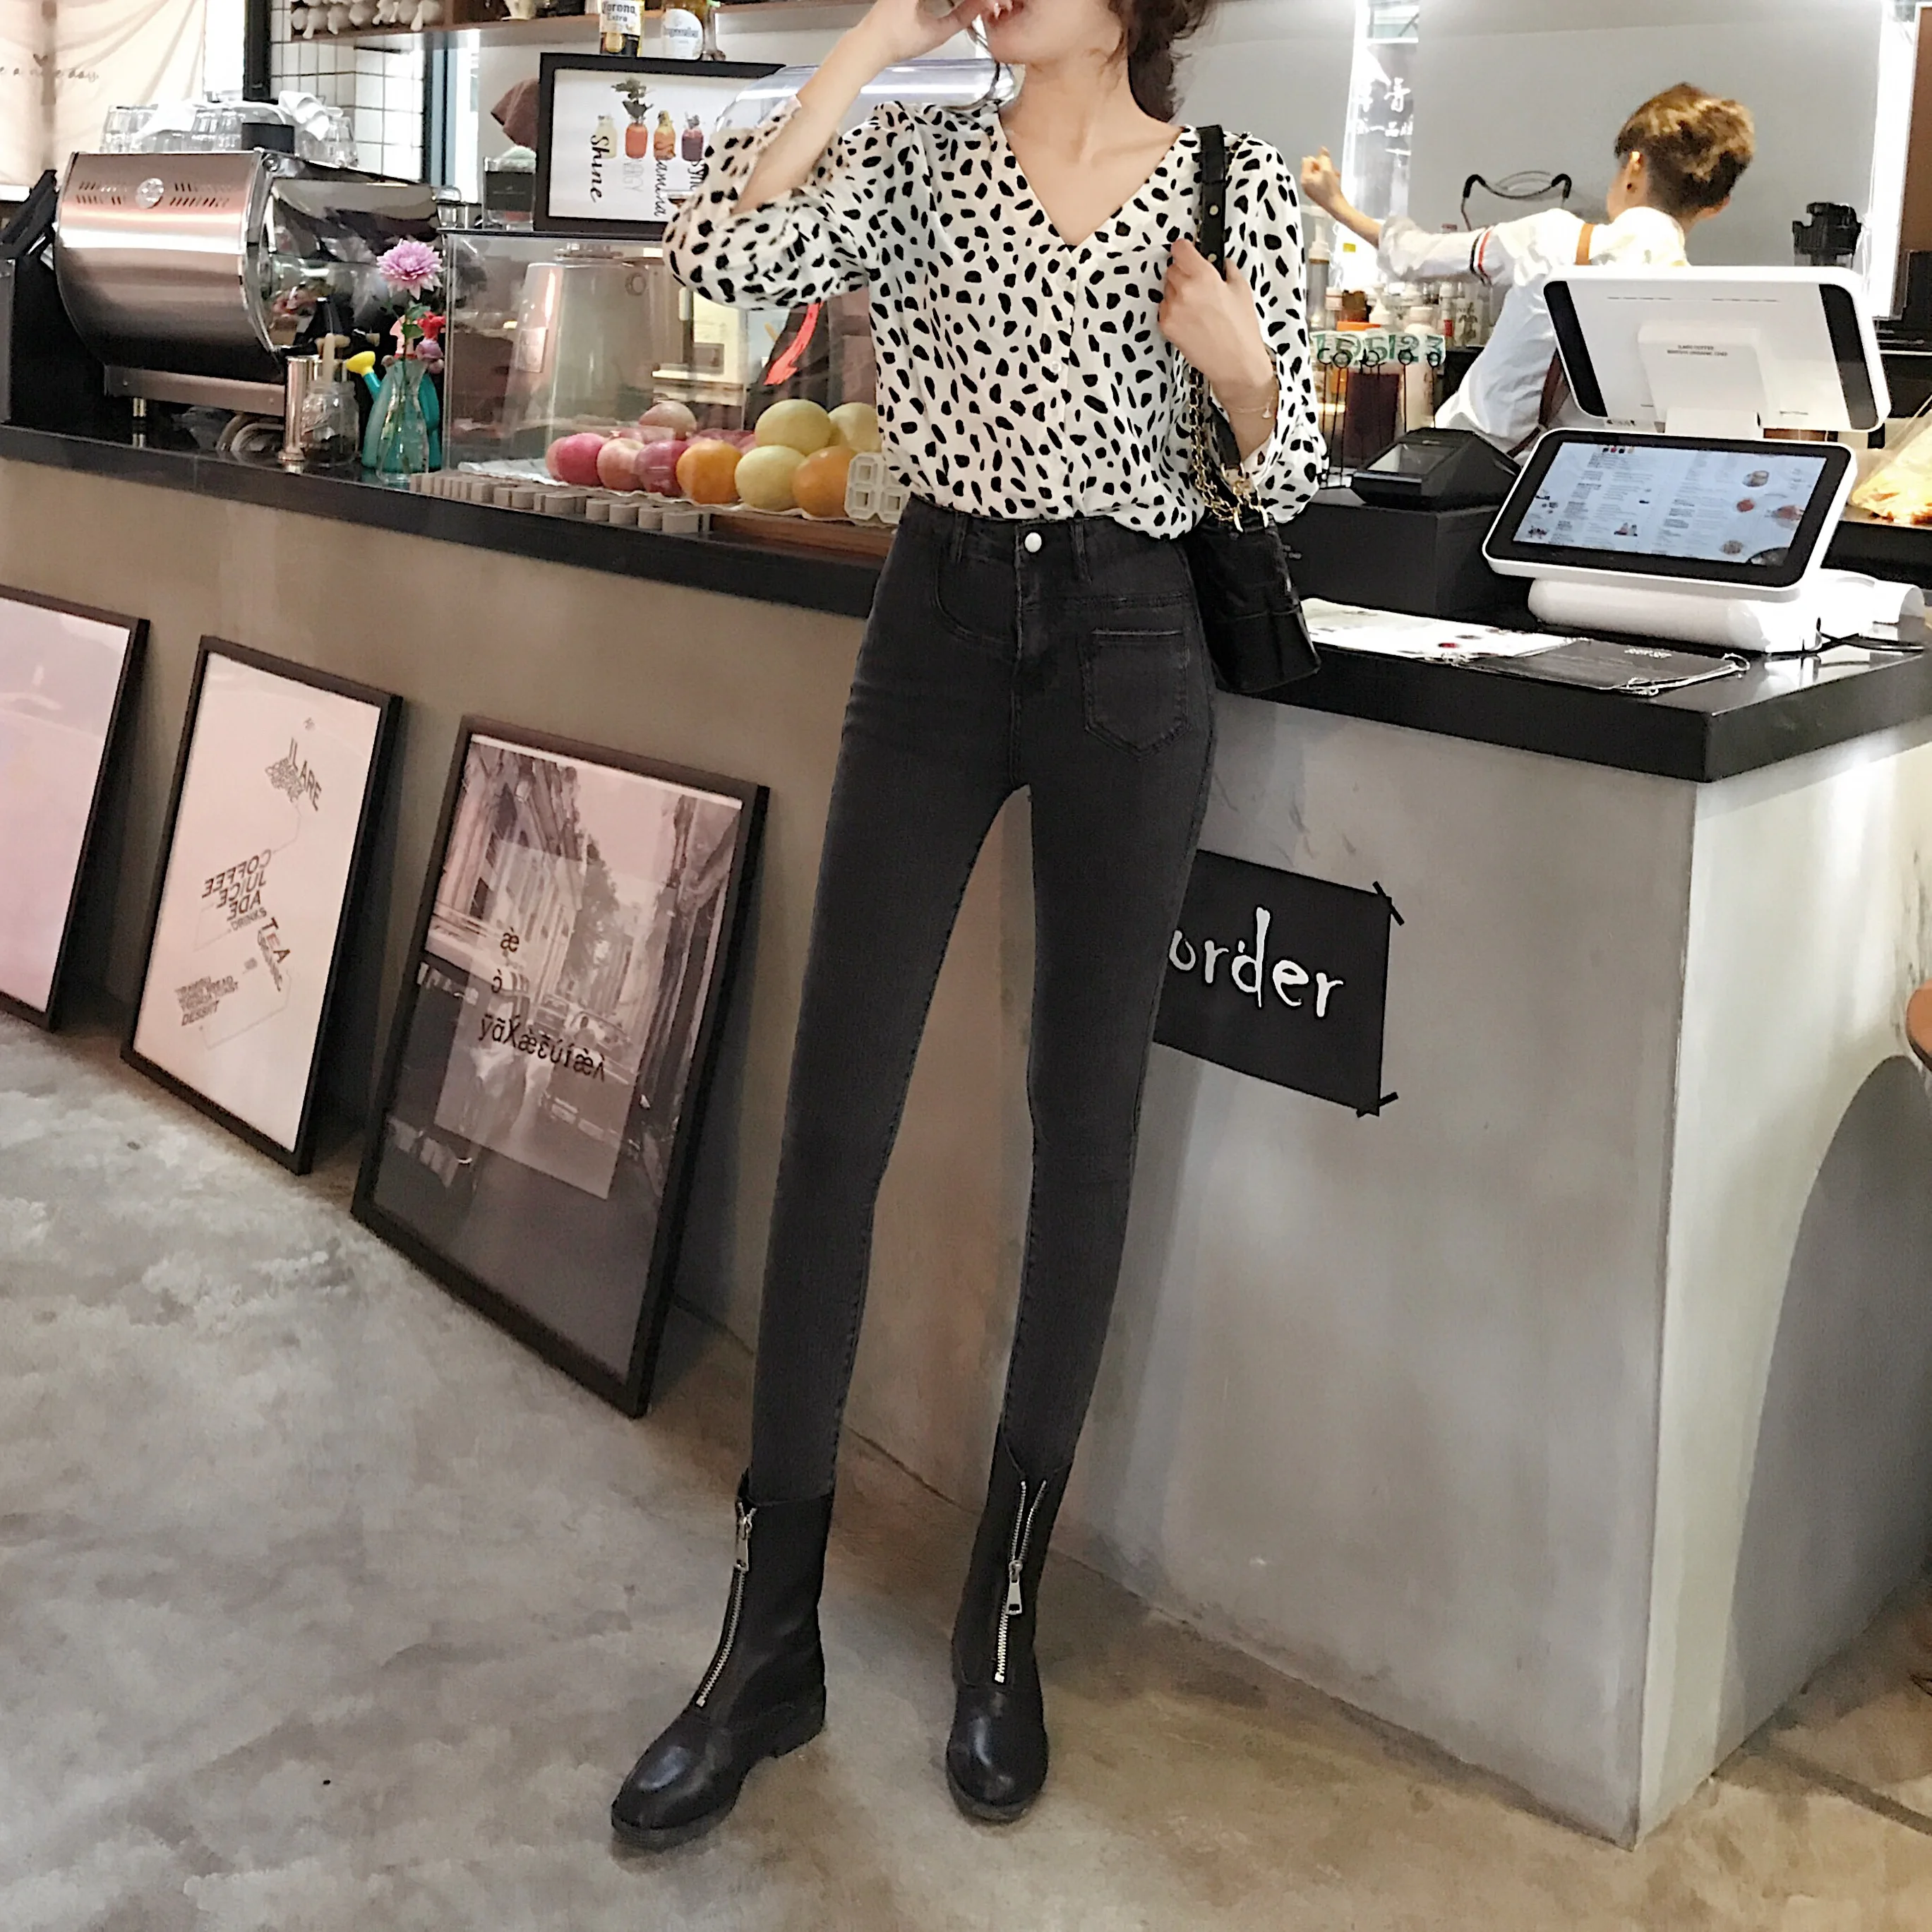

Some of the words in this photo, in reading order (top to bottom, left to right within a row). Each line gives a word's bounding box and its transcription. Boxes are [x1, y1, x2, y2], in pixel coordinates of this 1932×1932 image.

[601, 0, 637, 16] Corona
[590, 134, 610, 203] Shine
[261, 916, 291, 964] TEA
[1168, 906, 1344, 1018] order
